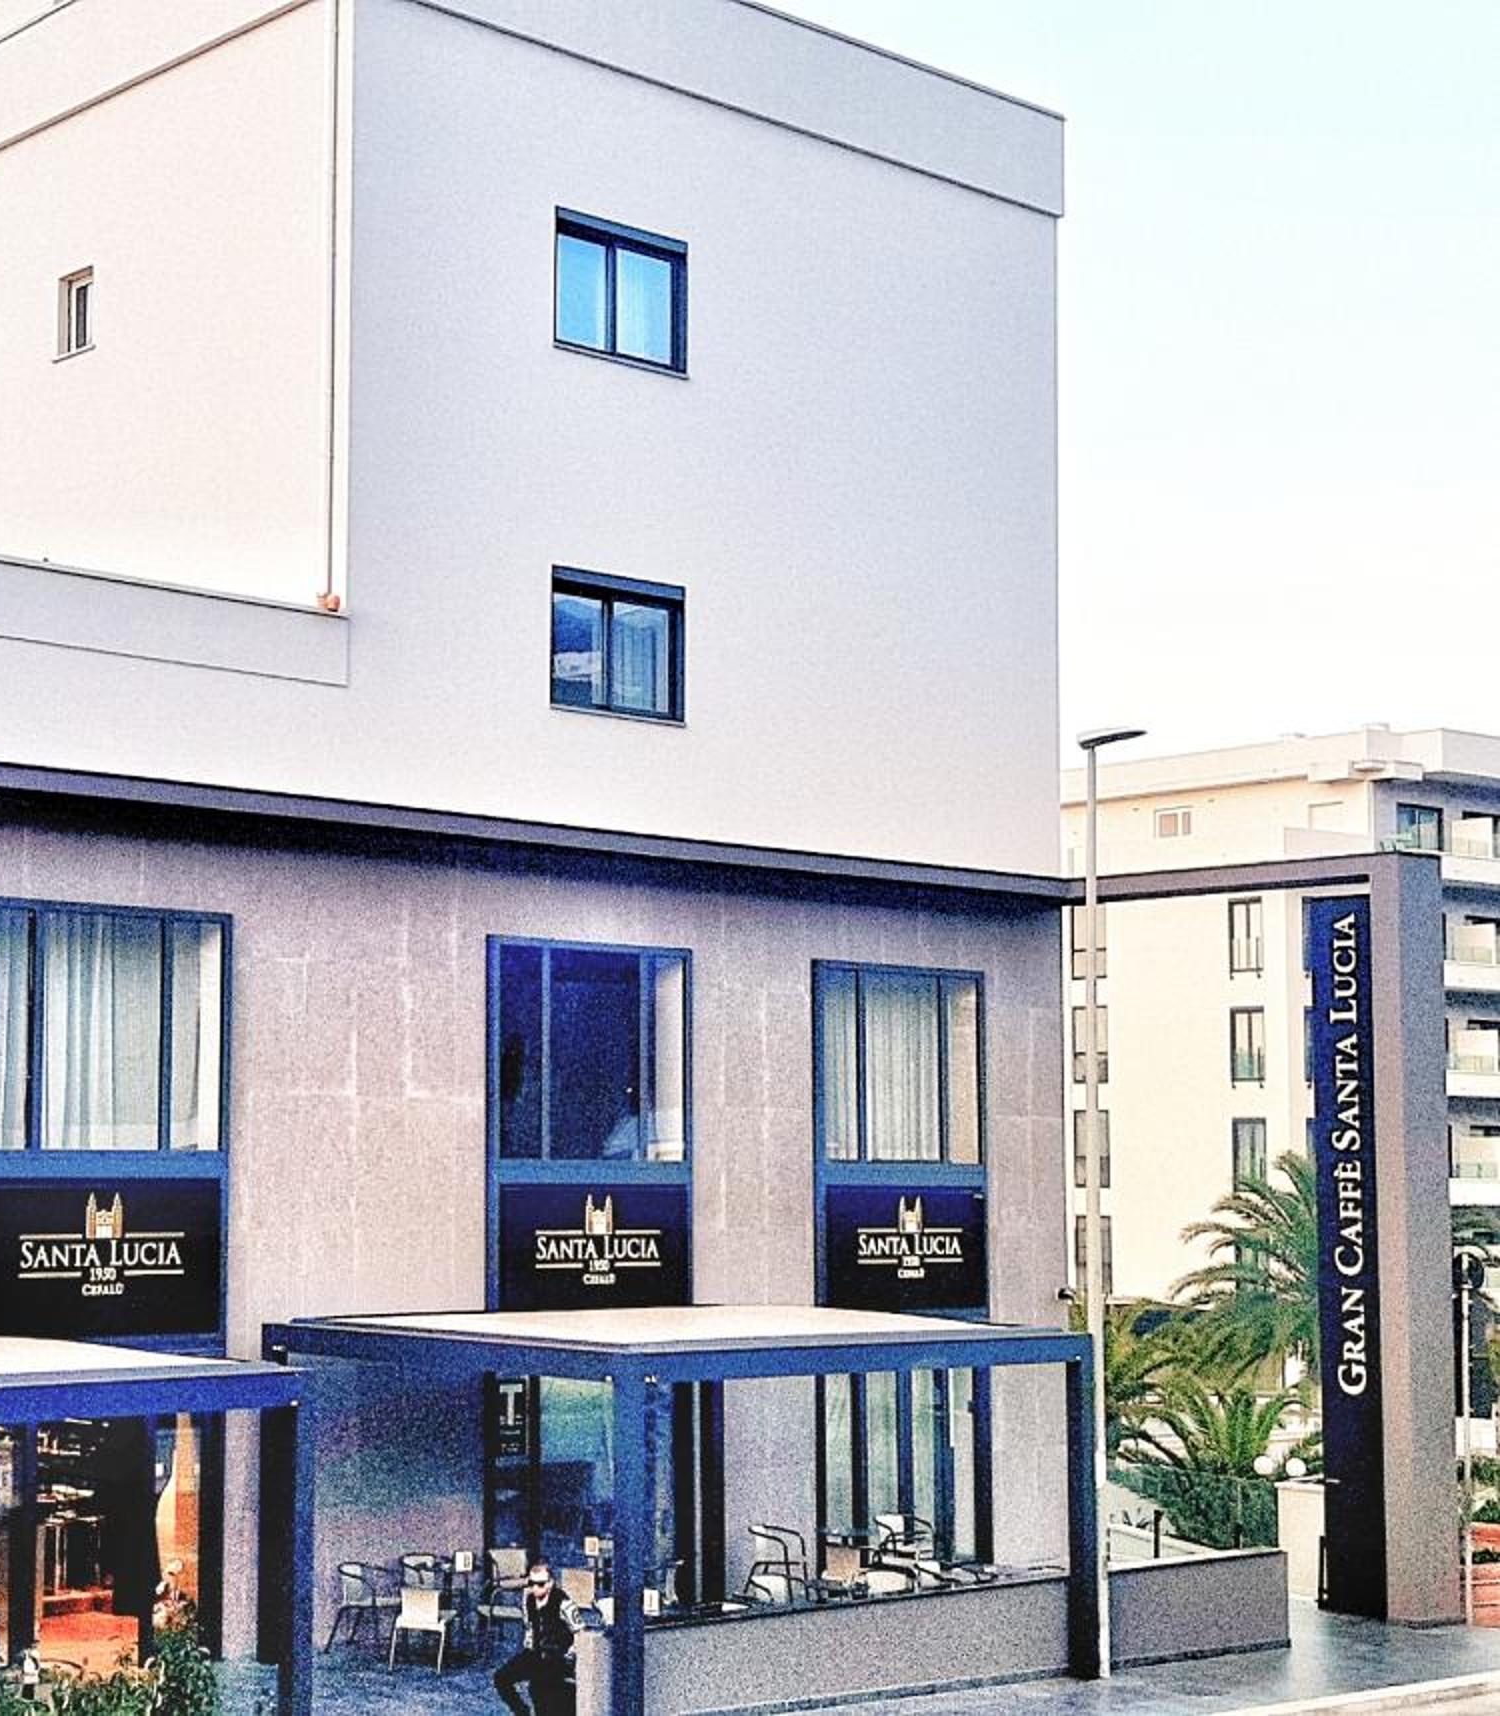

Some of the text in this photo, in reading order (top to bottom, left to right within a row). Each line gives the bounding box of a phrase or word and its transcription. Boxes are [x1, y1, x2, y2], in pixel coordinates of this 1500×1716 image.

[1329, 913, 1368, 1396] GRAN CAFFÈ SANTA LUCIA
[20, 1240, 181, 1268] SANTA LUCIA
[536, 1235, 659, 1259] SANTA LUCIA
[858, 1234, 961, 1256] SANTA LUCIA
[90, 1267, 117, 1281] 1950
